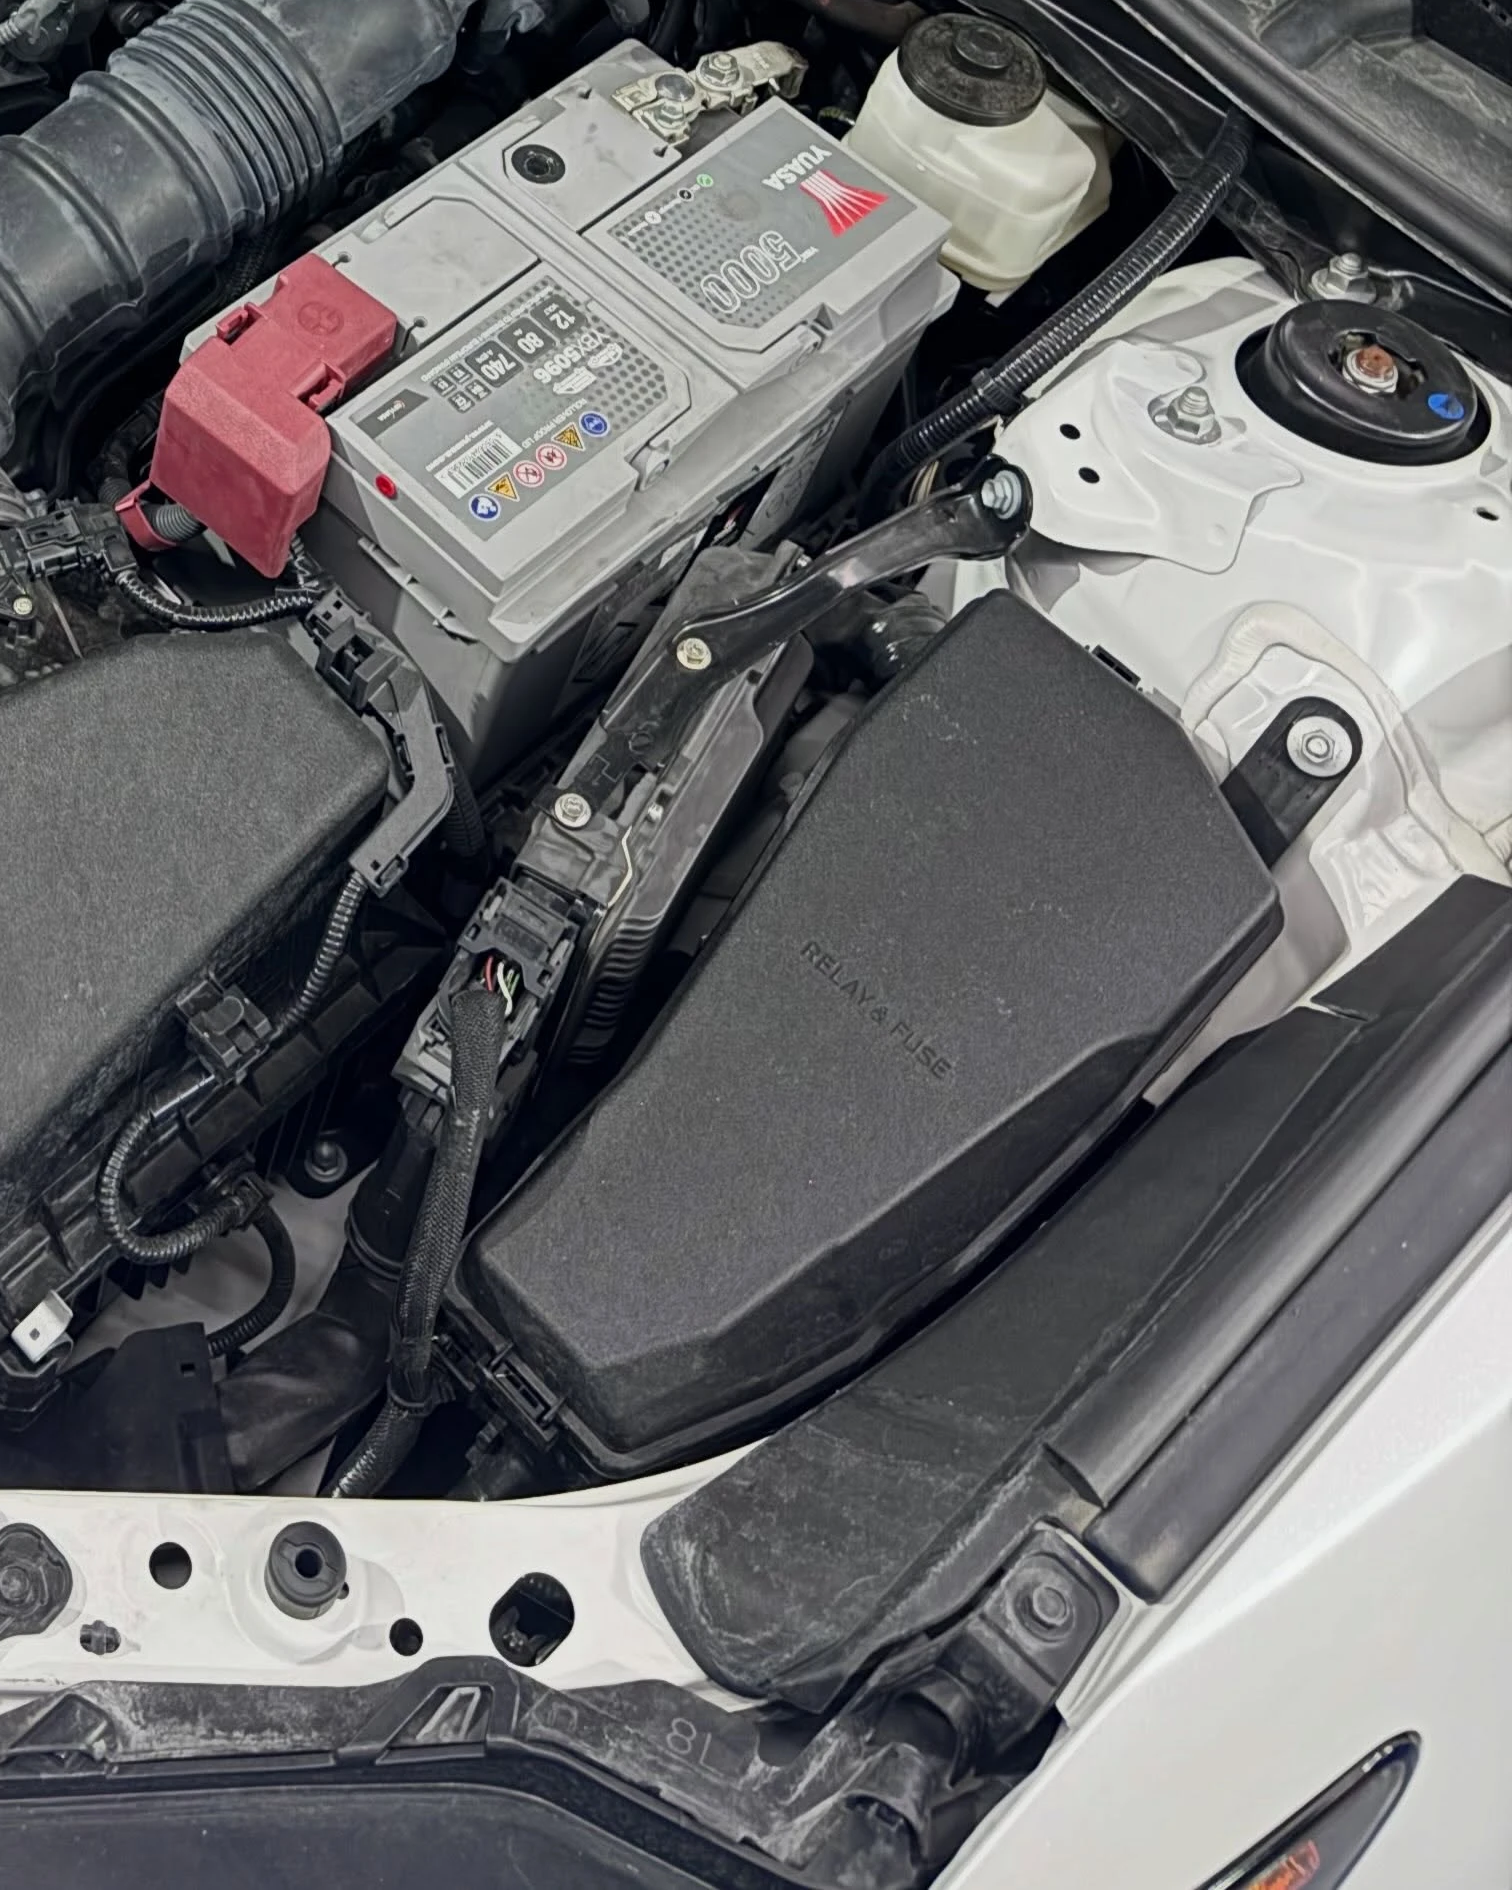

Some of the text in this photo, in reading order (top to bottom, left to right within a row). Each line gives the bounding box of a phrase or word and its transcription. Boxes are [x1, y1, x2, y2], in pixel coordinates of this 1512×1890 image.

[761, 143, 832, 192] YUASA
[697, 228, 803, 315] 5000
[547, 307, 576, 330] 12
[515, 329, 545, 355] 80
[531, 325, 609, 386] YBX5096
[478, 352, 516, 381] 740
[531, 420, 555, 440] PROOF
[552, 397, 587, 425] ROLLOVER
[800, 941, 953, 1080] RELAY & FUSE
[665, 1716, 724, 1777] 8L
